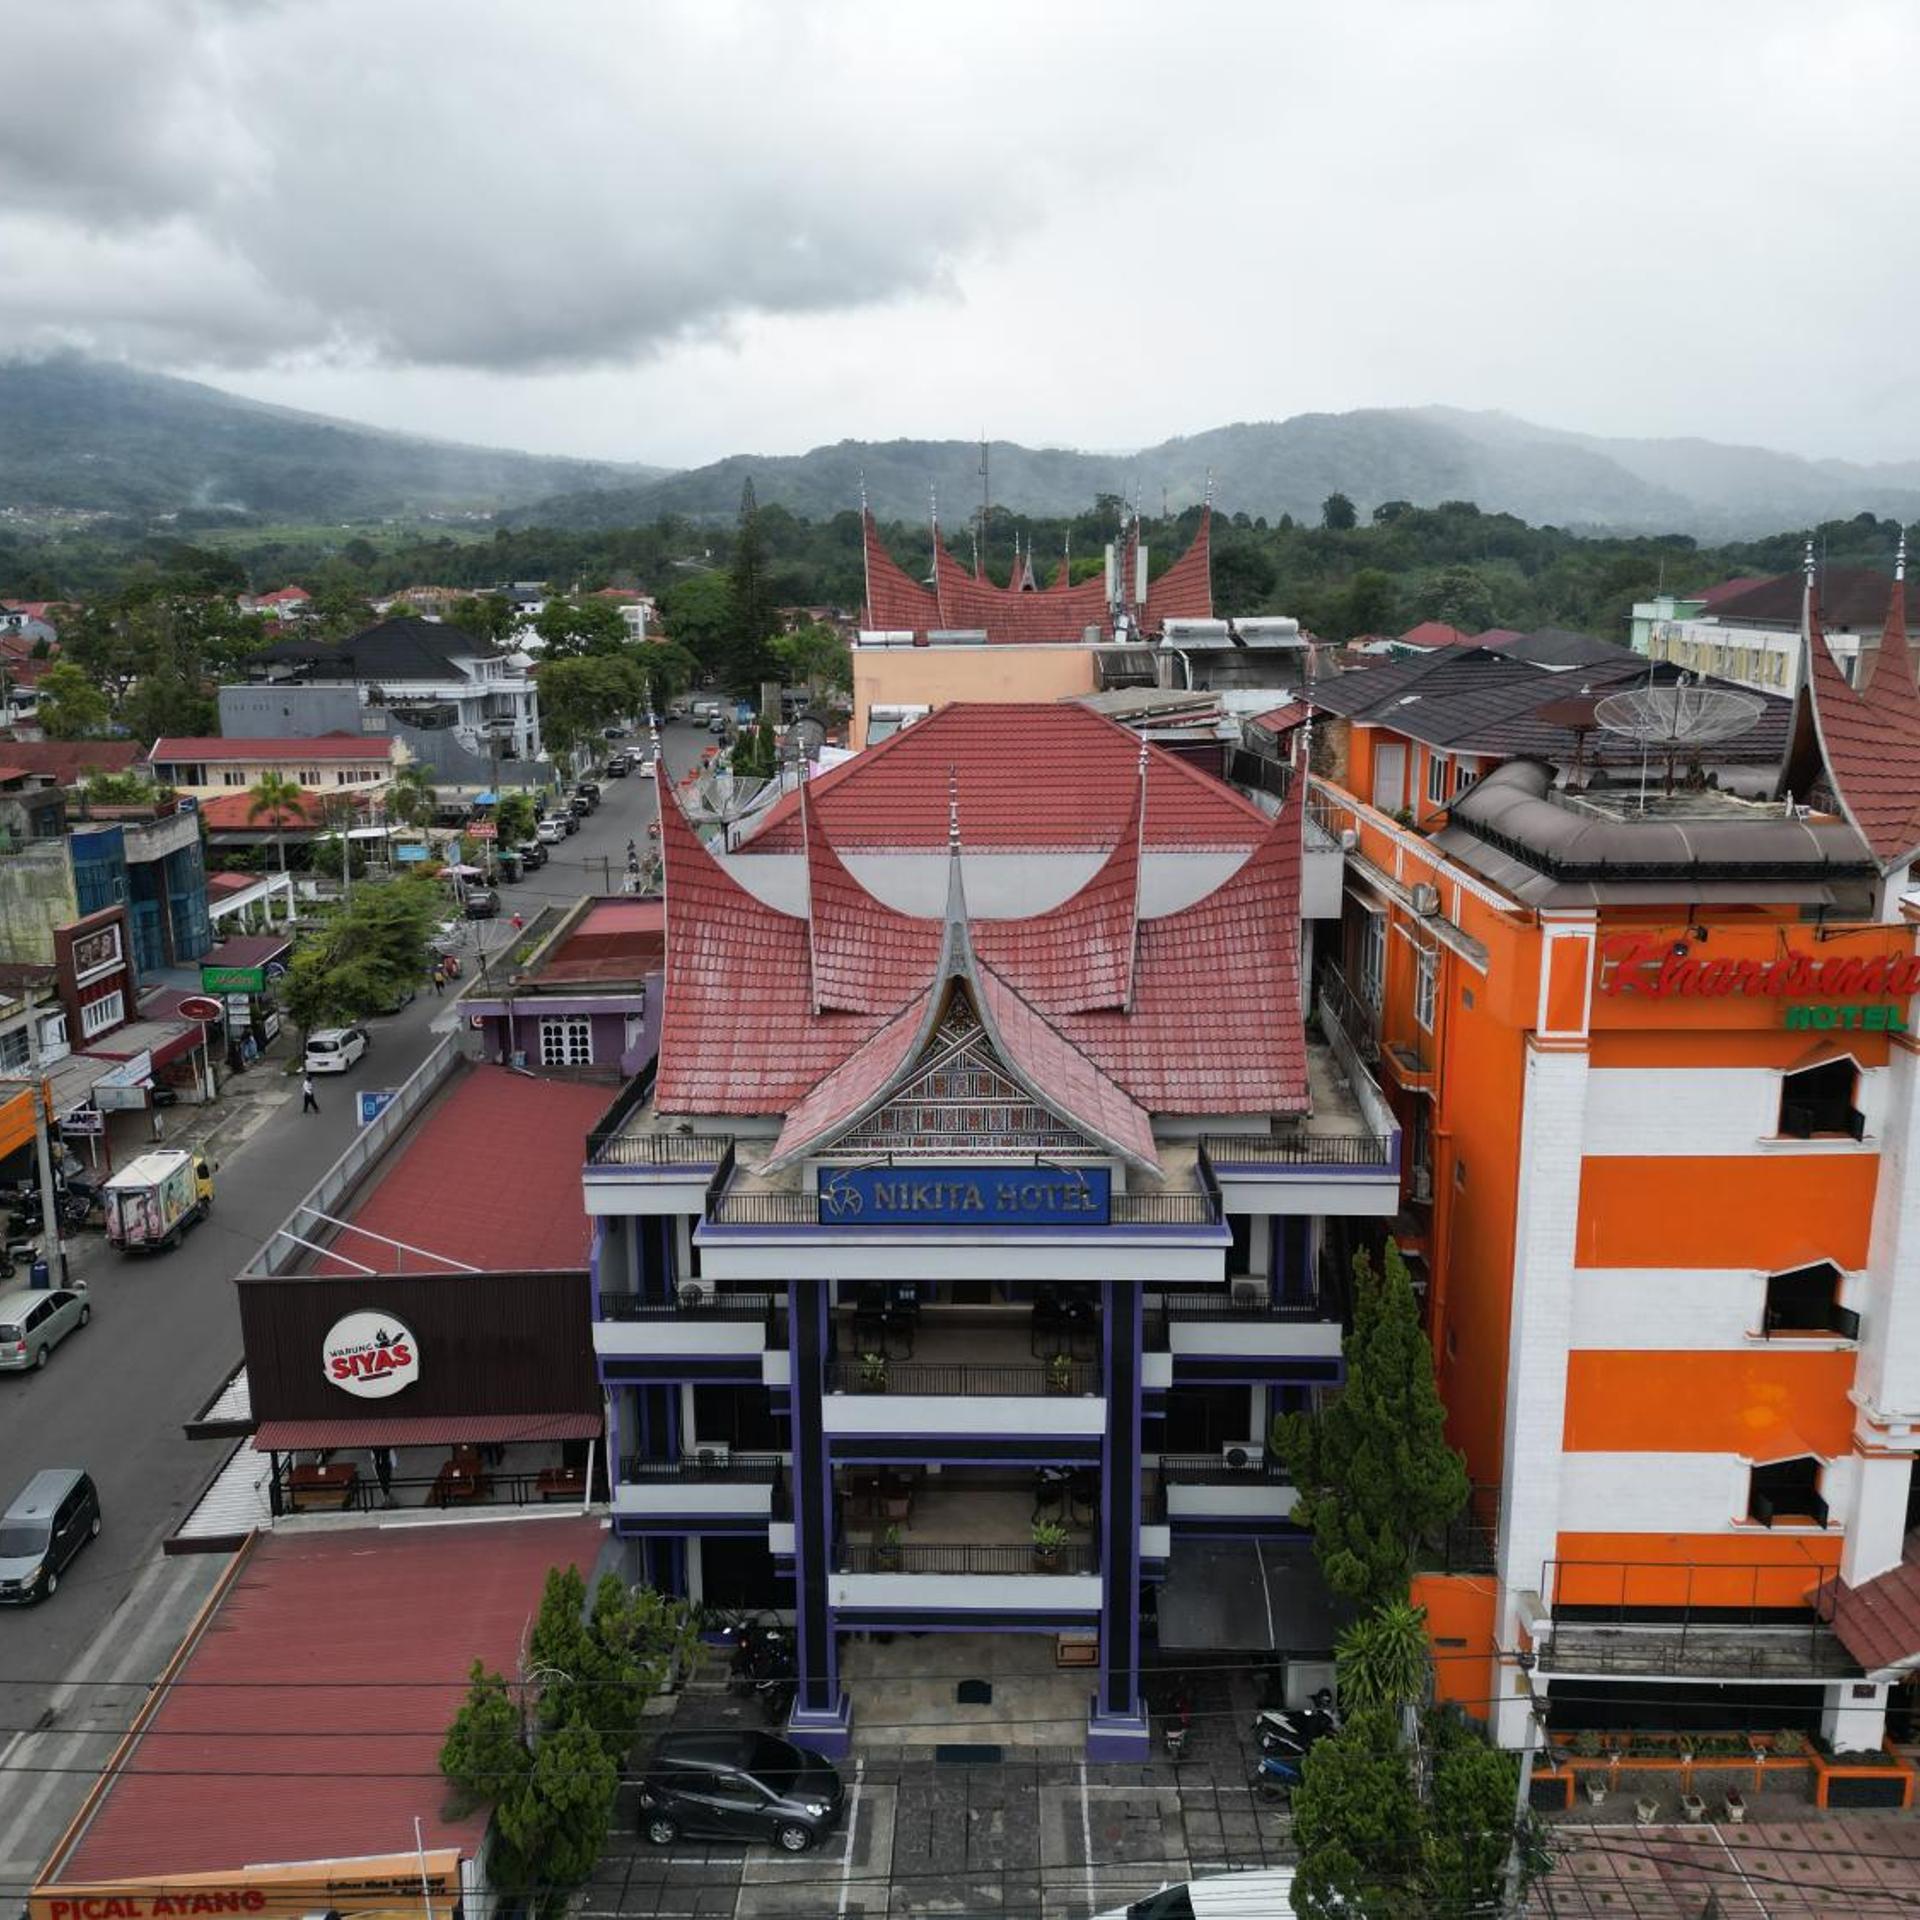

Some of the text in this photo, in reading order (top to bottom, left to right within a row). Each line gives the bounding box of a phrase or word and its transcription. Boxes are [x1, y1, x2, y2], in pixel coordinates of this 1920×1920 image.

[1785, 1005, 1908, 1031] HOTEL
[874, 1182, 1101, 1211] NIKITA HOTEL
[329, 1343, 373, 1357] WARUNG
[332, 1344, 412, 1379] SIYAS
[50, 1890, 267, 1920] PICAL AYANG
